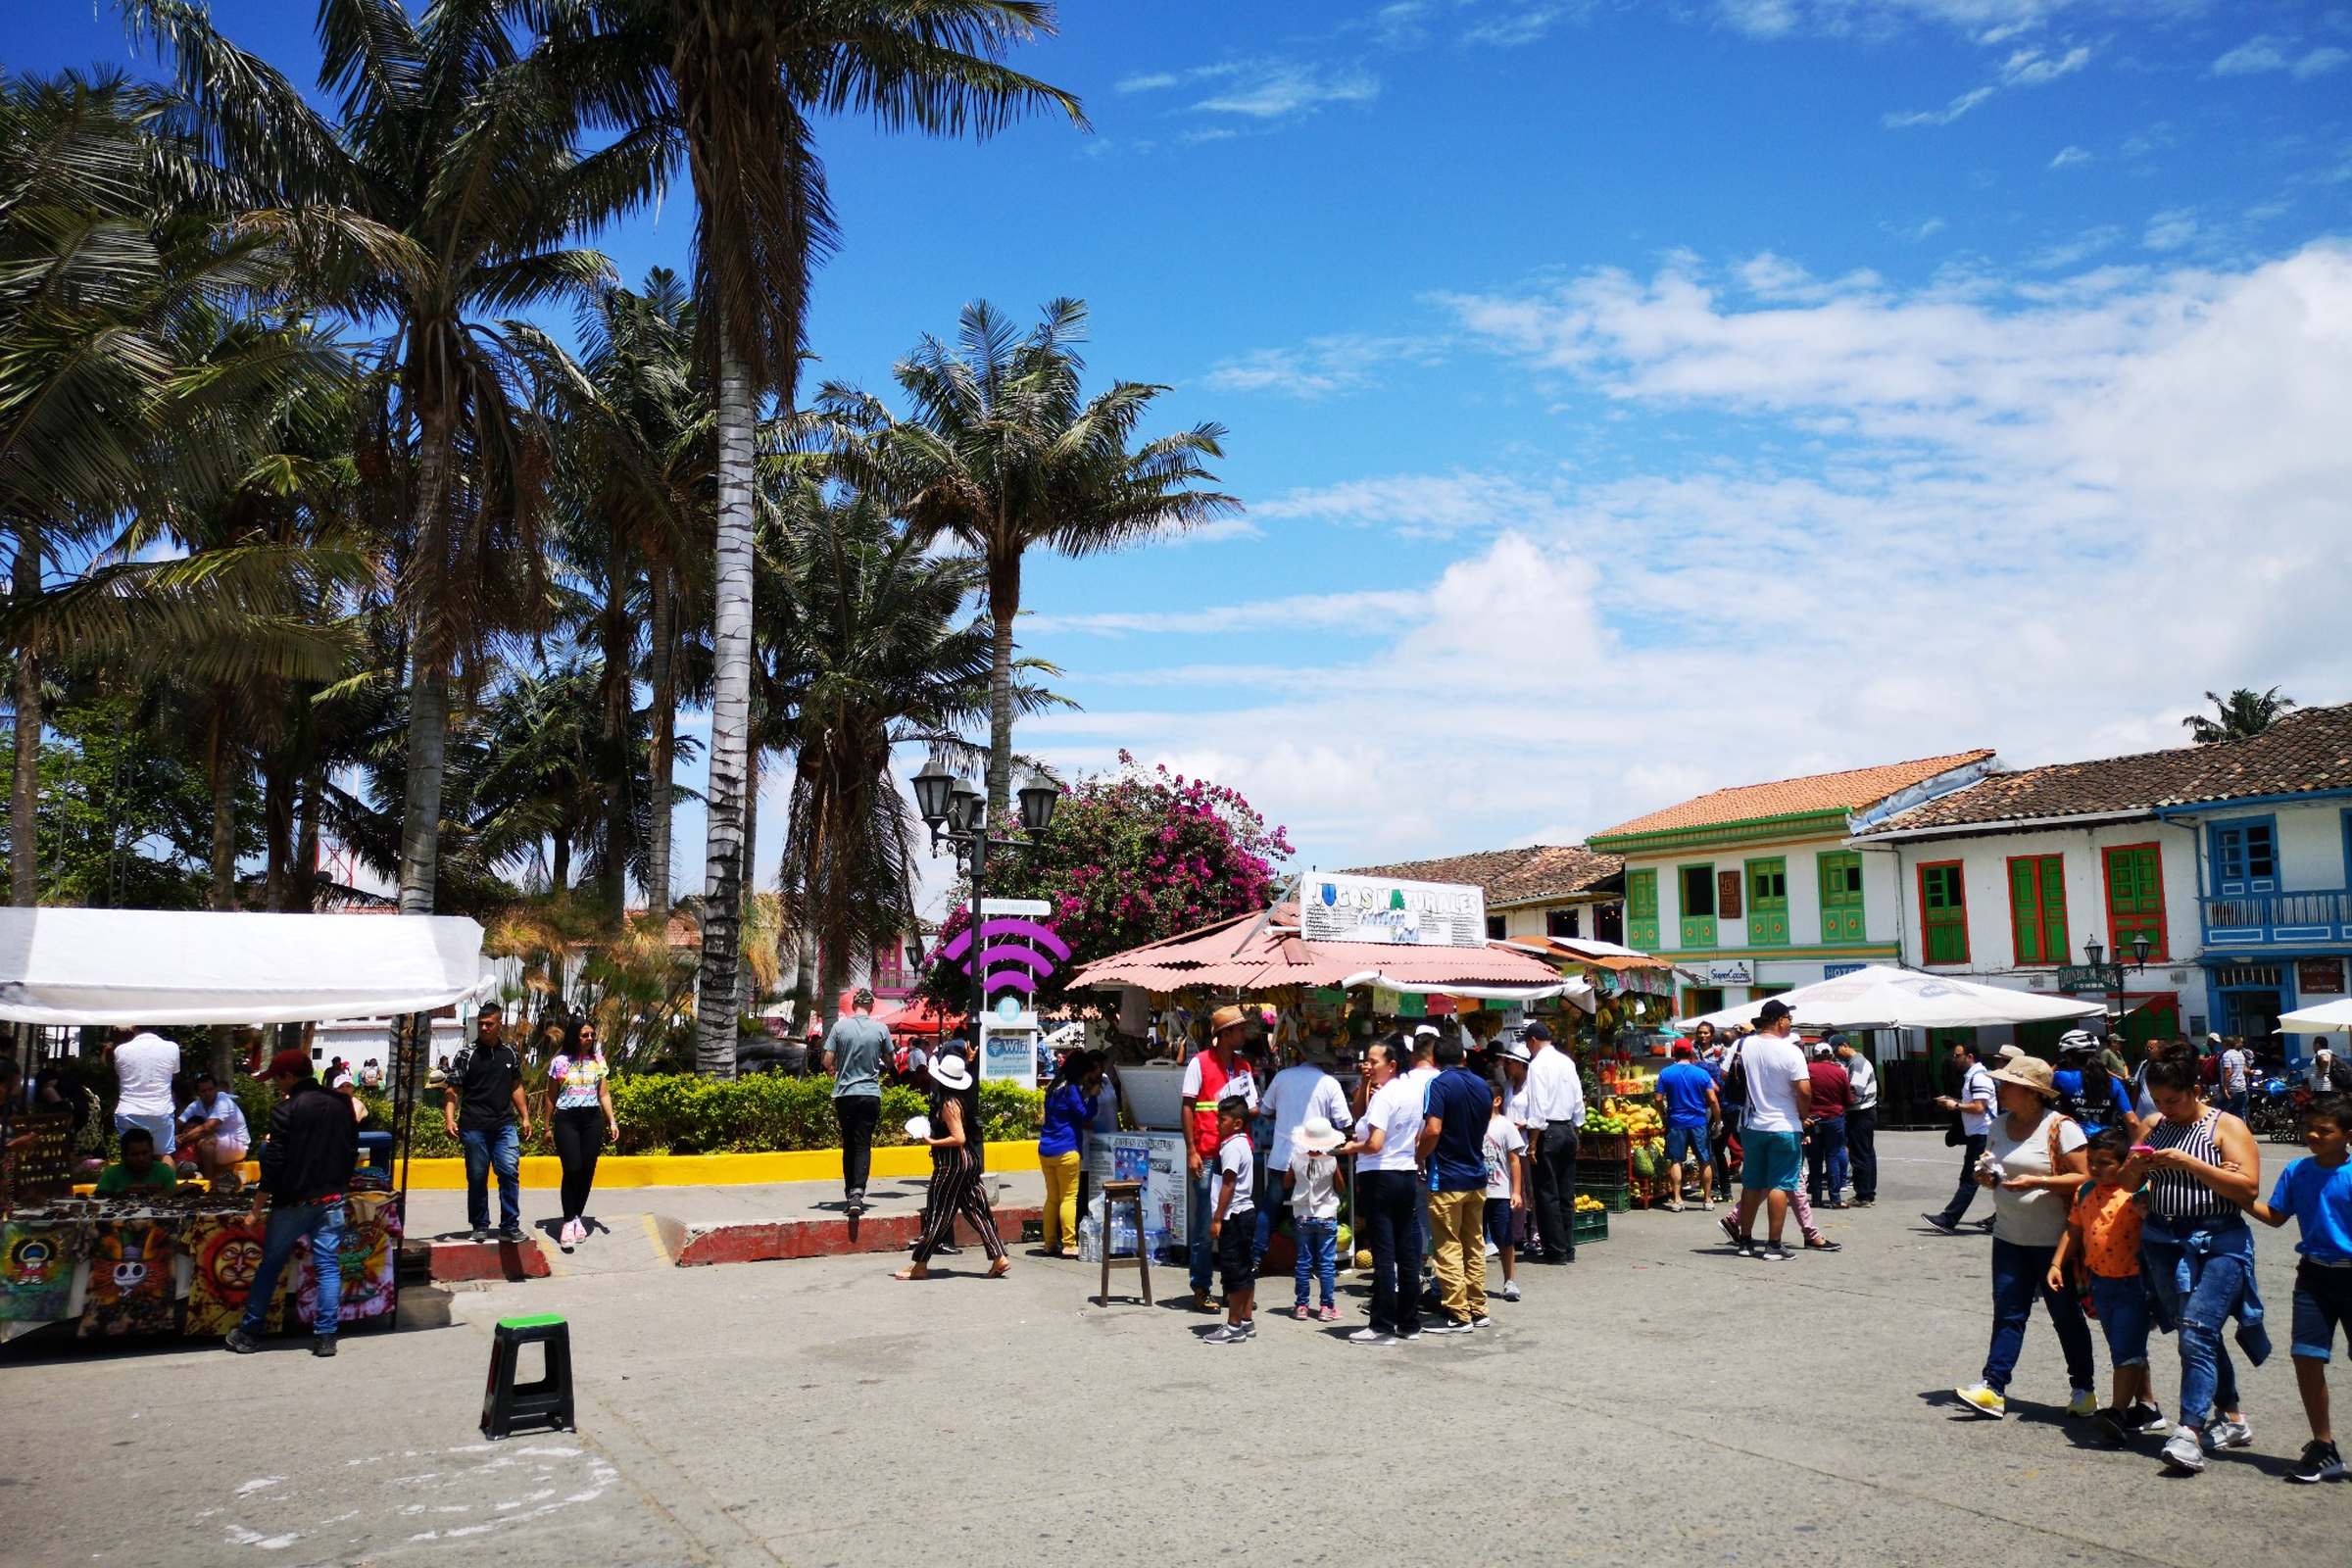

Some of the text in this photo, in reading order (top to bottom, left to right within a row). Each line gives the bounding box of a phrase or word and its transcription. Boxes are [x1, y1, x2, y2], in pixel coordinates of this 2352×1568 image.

[1312, 882, 1479, 915] JUGOS NATURALES
[1826, 968, 1860, 978] HOTE
